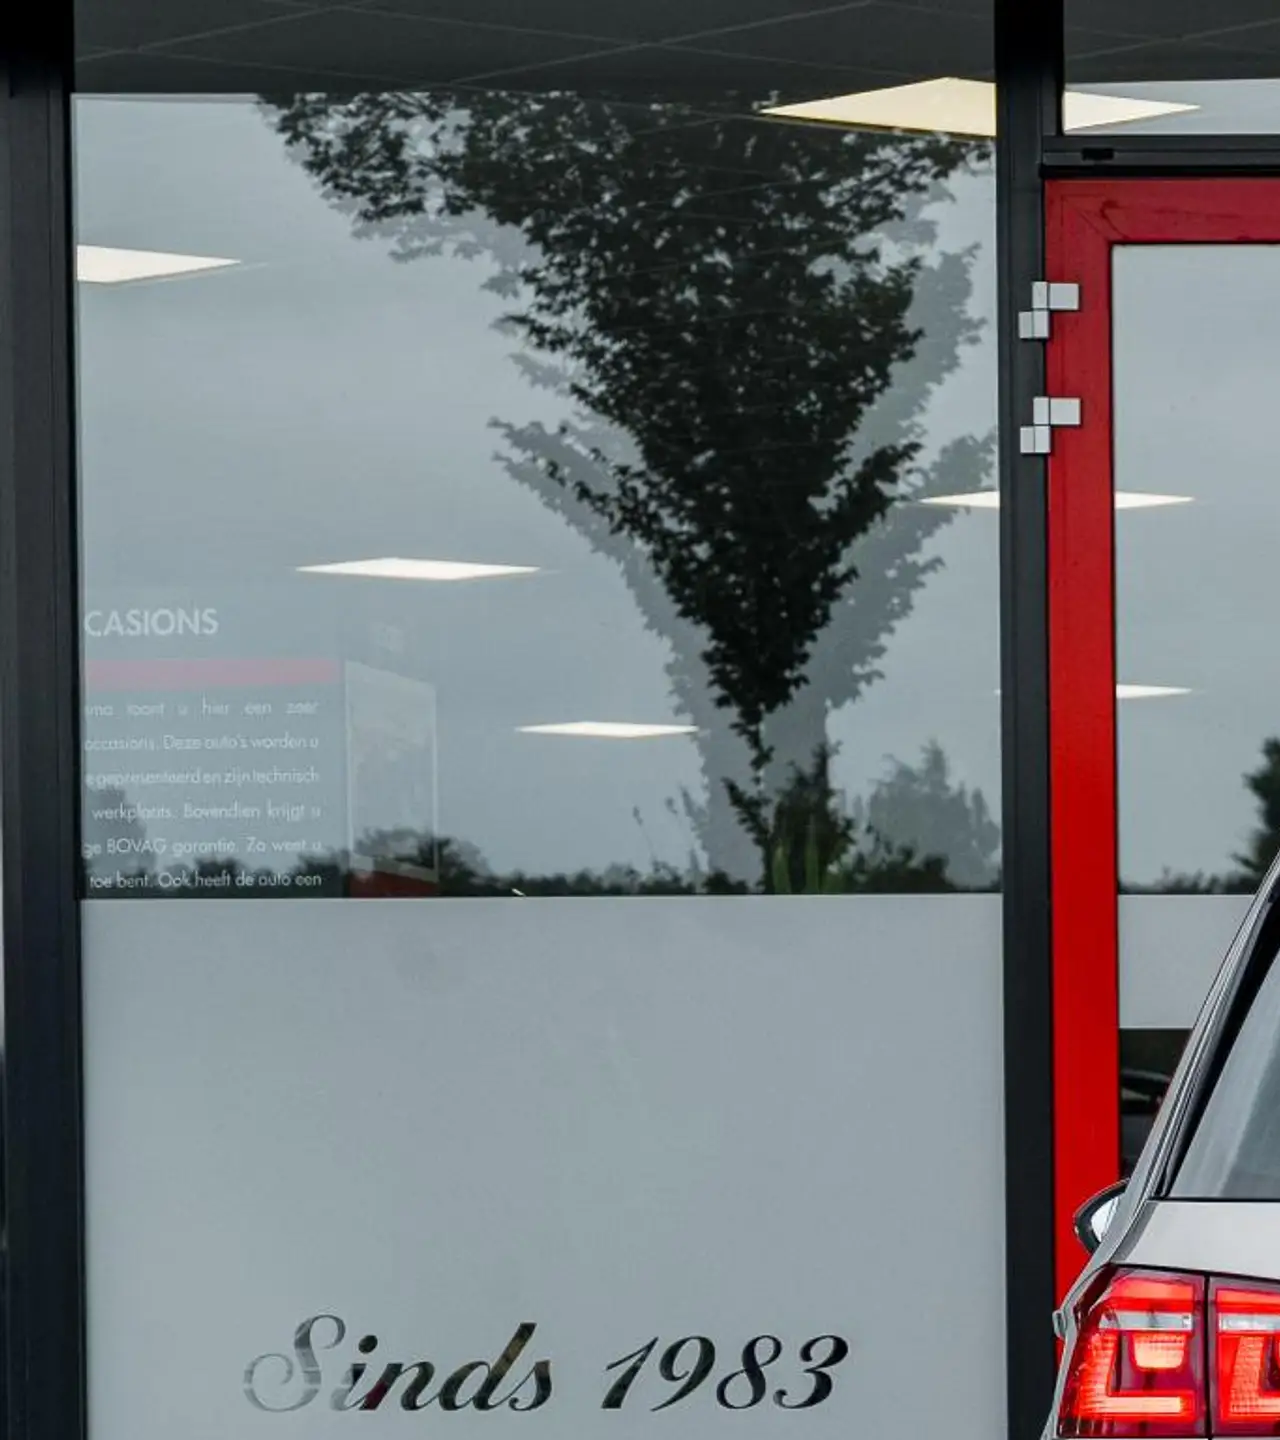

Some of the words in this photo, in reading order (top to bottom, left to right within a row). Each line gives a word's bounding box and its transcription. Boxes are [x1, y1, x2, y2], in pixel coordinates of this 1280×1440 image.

[83, 604, 220, 638] CASIONS
[107, 838, 167, 854] BOVAG
[235, 870, 255, 887] de
[258, 871, 291, 887] auto
[242, 1313, 552, 1413] Sinds
[600, 1334, 849, 1413] 1983
